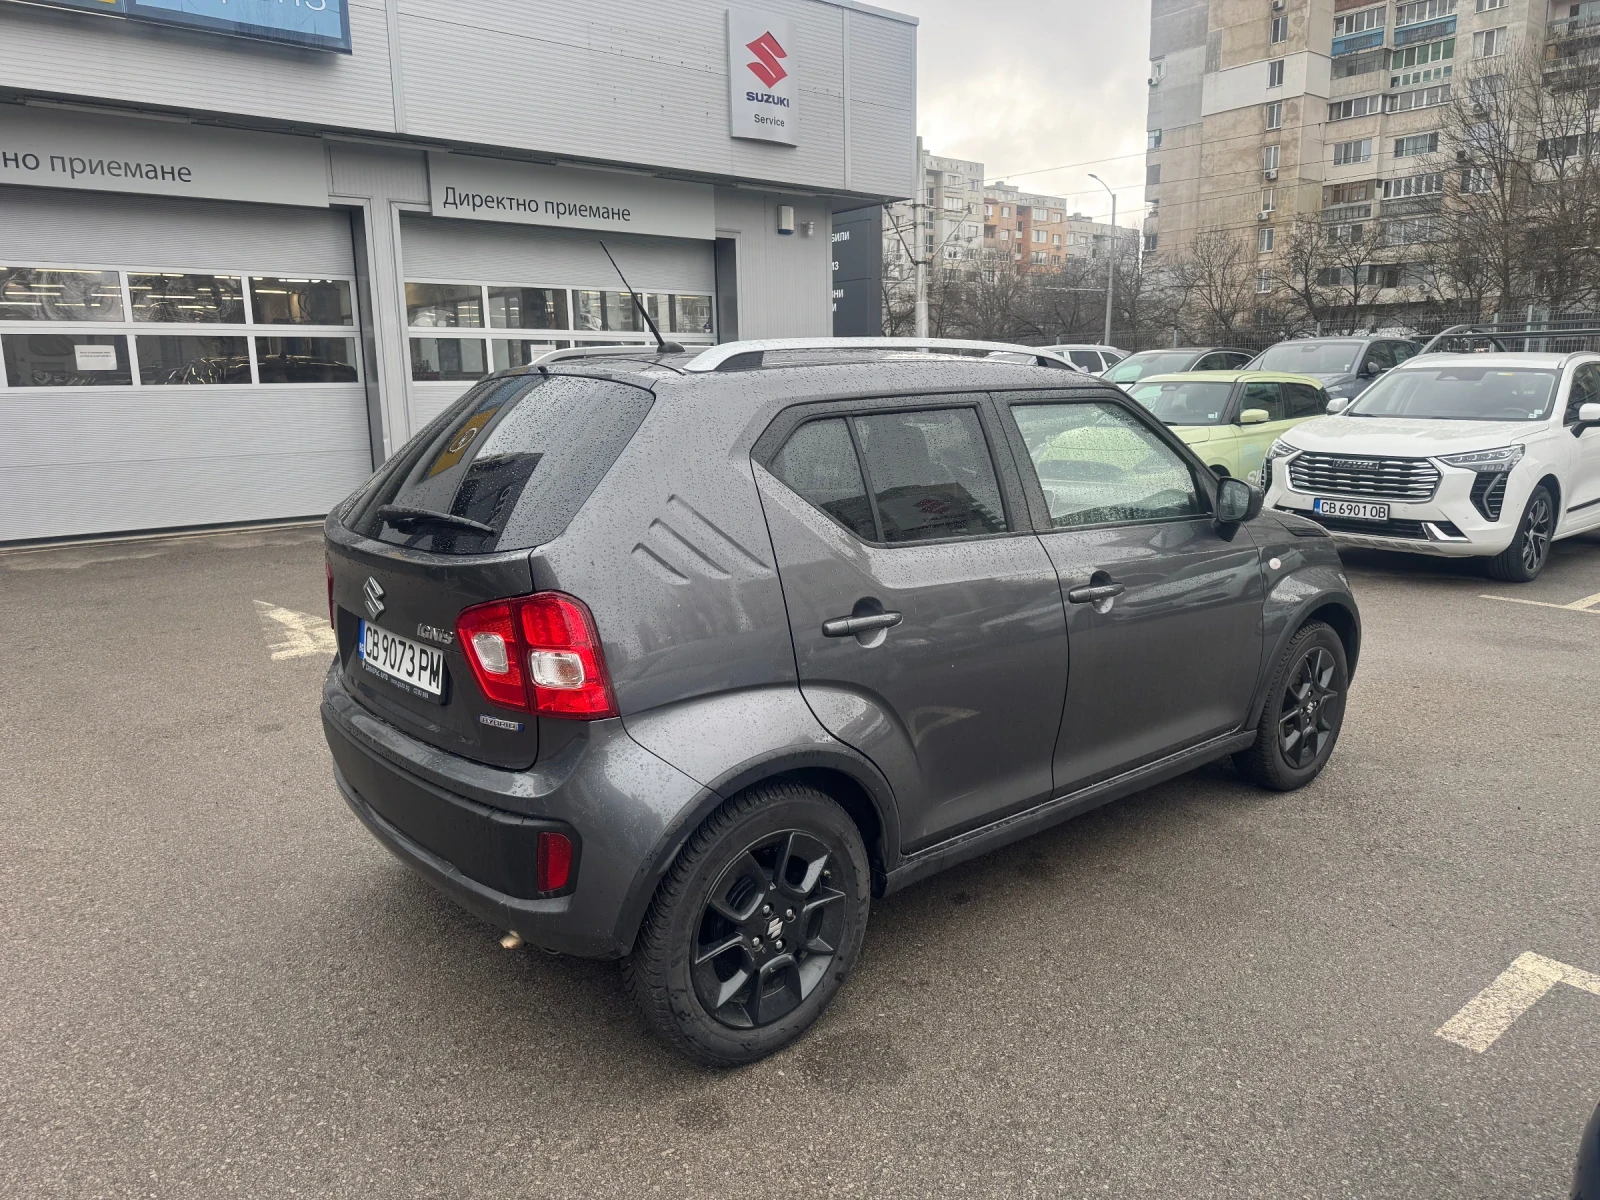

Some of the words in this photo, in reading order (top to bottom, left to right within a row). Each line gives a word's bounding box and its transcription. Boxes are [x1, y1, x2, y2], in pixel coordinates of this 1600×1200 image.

[745, 91, 790, 108] SUZUKI
[754, 113, 785, 127] Service
[49, 154, 192, 183] приемане
[443, 186, 539, 213] Директно
[544, 200, 631, 222] приемане
[1333, 459, 1378, 470] HAVAL
[1321, 501, 1336, 514] CB
[1338, 503, 1367, 517] 6901
[416, 622, 455, 645] IGNIS
[365, 626, 380, 661] CB
[382, 634, 415, 678] 9073
[418, 648, 441, 690] PM
[481, 716, 516, 730] HYBRID
